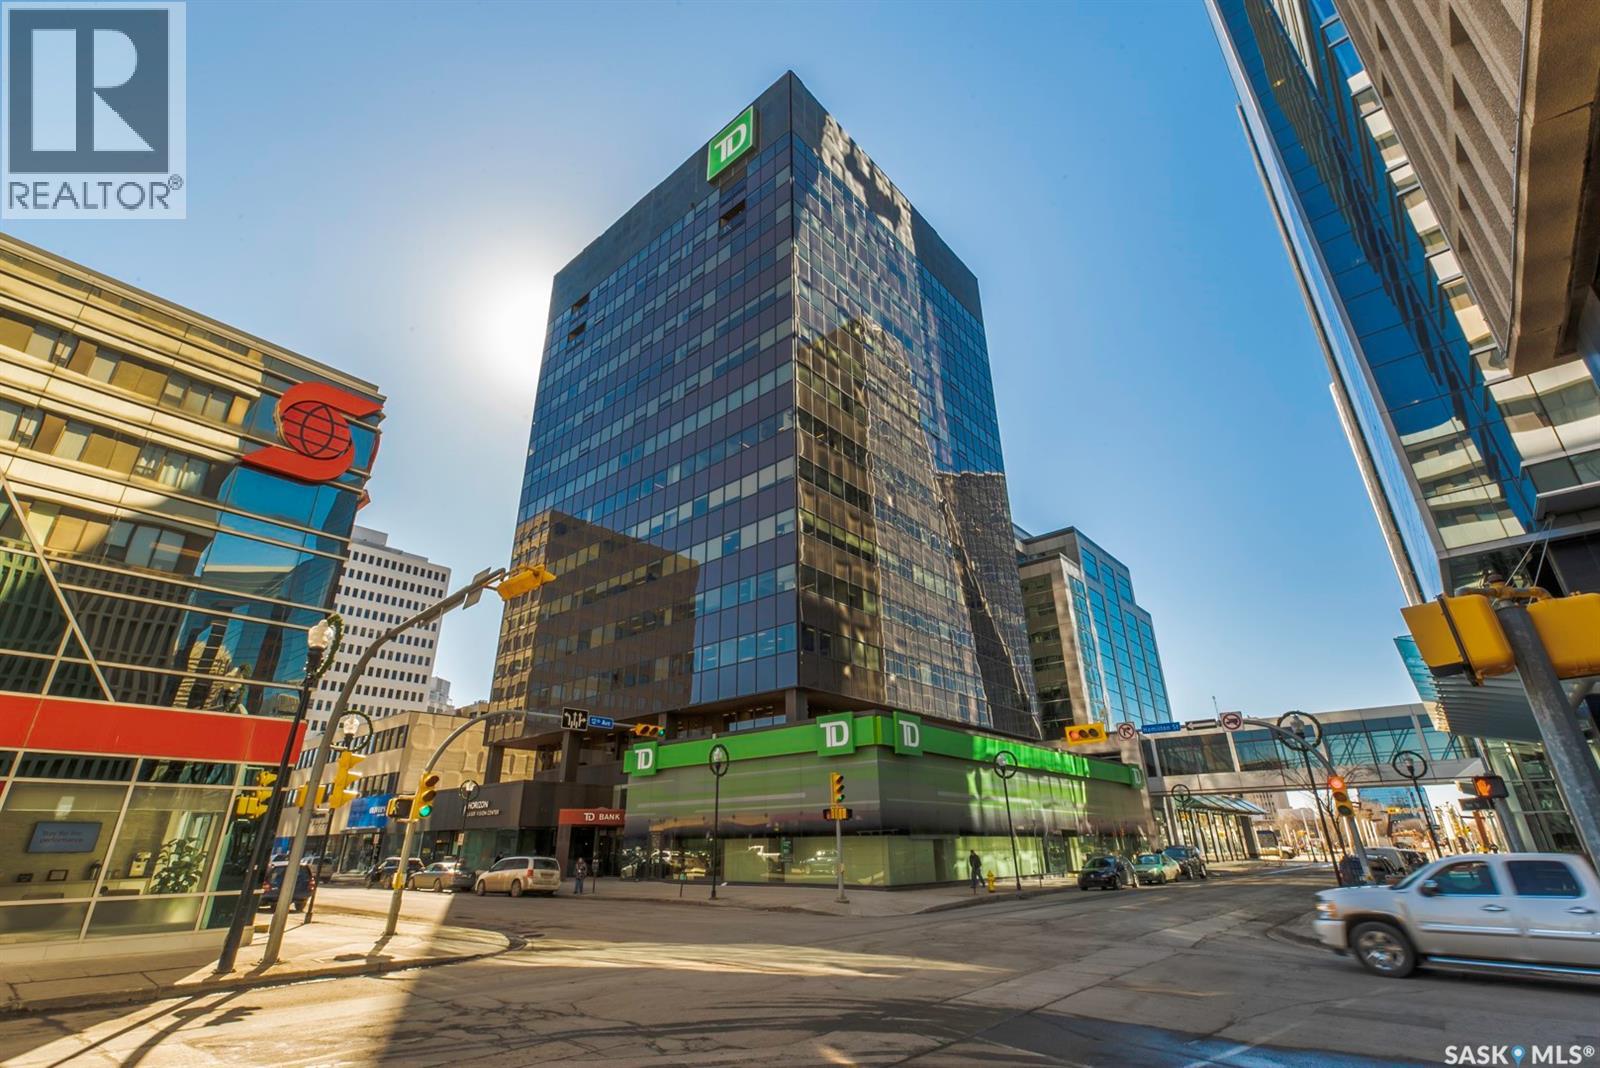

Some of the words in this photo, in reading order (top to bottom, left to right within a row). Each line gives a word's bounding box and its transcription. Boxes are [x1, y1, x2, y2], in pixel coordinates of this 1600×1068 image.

[714, 123, 747, 162] TD
[602, 719, 611, 727] Ave
[820, 721, 849, 748] TD
[898, 720, 920, 748] TD
[634, 748, 653, 770] TD
[584, 812, 595, 822] TD
[598, 813, 621, 821] BANK
